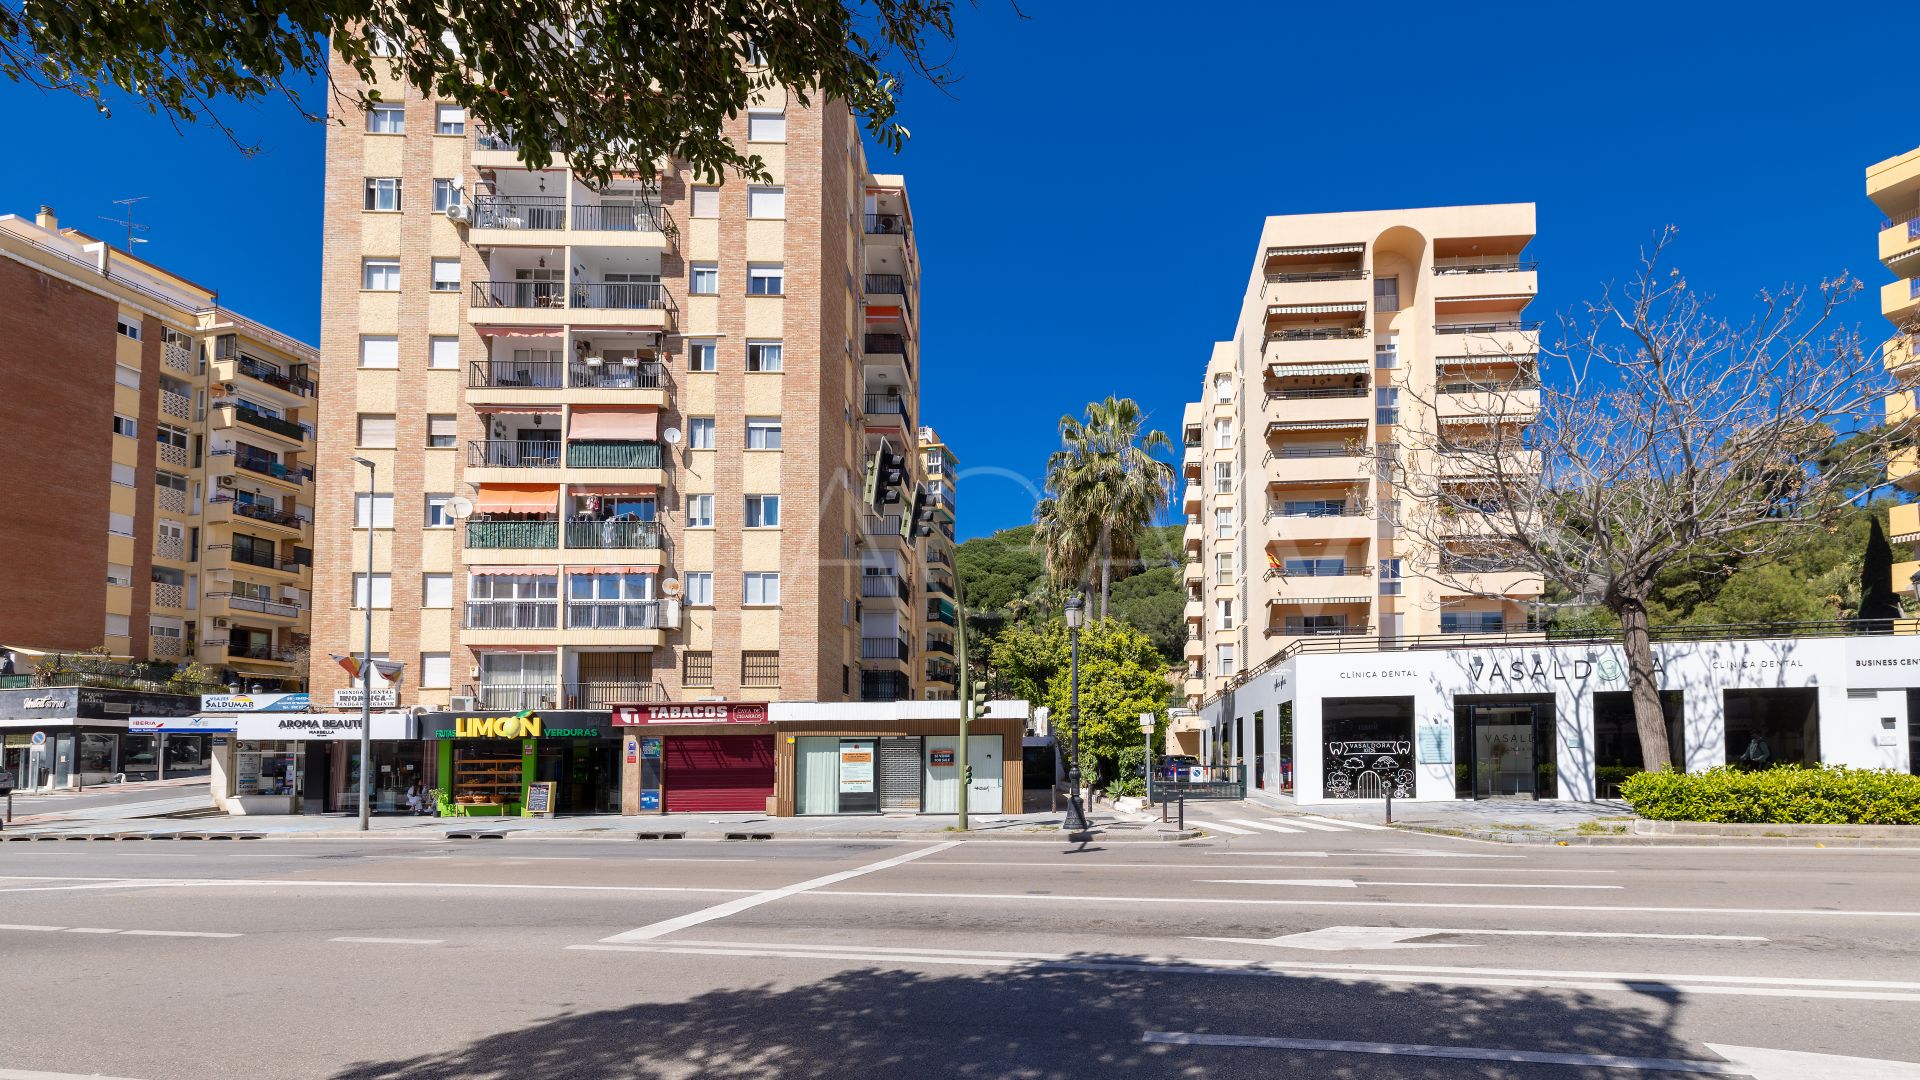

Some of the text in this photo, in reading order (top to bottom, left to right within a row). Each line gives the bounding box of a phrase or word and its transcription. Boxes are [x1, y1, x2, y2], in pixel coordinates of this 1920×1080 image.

[1761, 660, 1803, 668] DENTAL
[1855, 658, 1920, 667] BUSINESS CEN
[1381, 670, 1418, 678] DENTAL
[1469, 657, 1665, 682] VASALDOA
[205, 699, 254, 708] SALDUMAR
[648, 706, 727, 718] TABACOS
[278, 719, 320, 729] AROMA
[544, 728, 598, 737] VERDURAS
